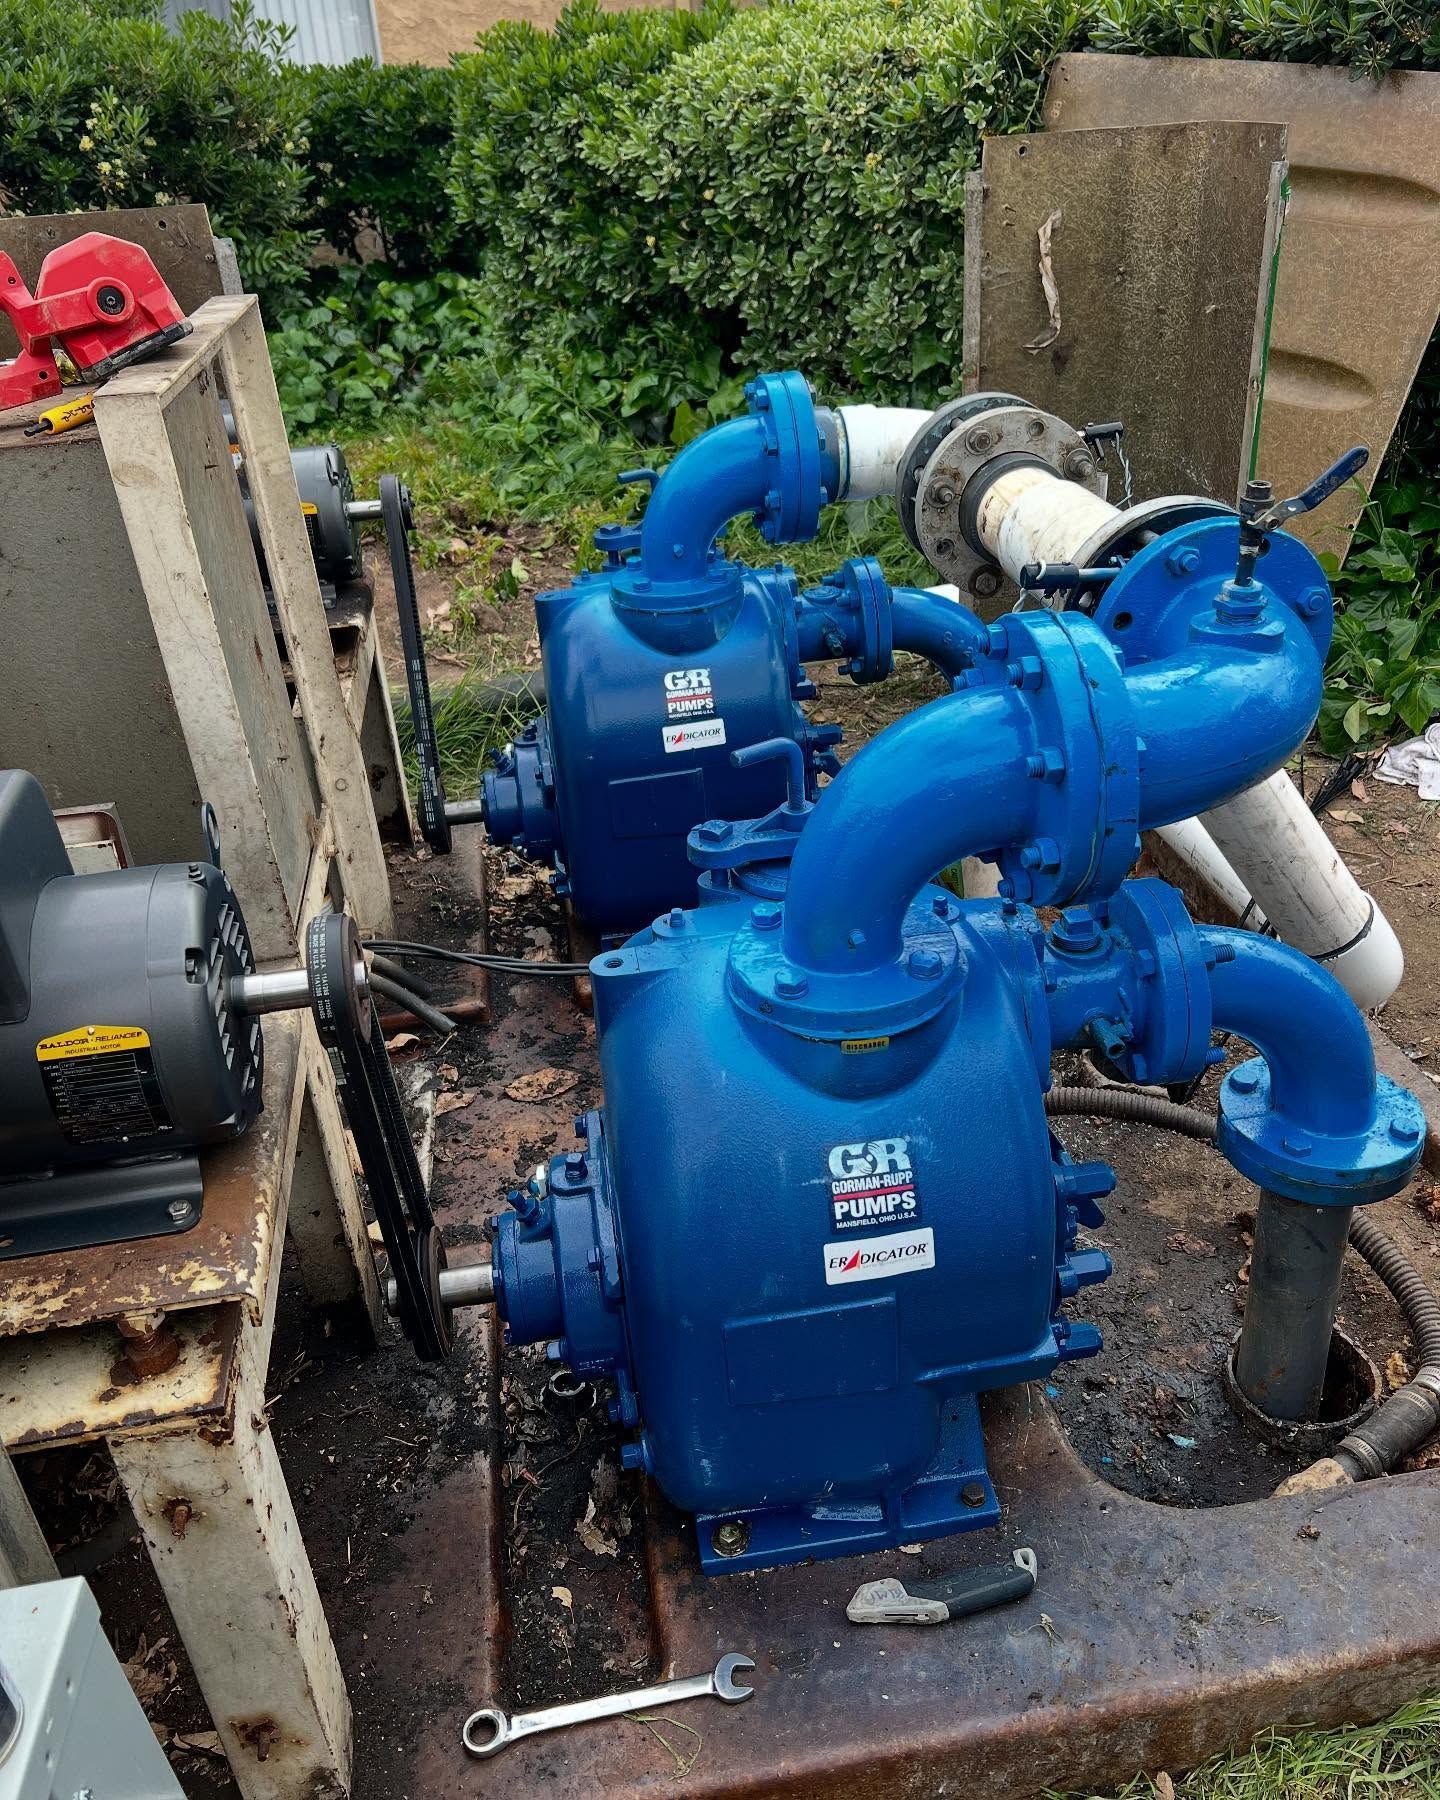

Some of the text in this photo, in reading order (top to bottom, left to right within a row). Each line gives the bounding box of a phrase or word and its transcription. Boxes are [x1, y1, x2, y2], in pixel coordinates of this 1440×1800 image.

[668, 698, 714, 713] PUMPS
[39, 1038, 89, 1050] BALDOR
[65, 1044, 121, 1055] INDUSTRIAL MOTOR
[832, 1171, 913, 1194] GORMAN-RUPP
[834, 1191, 916, 1220] PUMPS
[836, 1218, 878, 1229] MANSFIELD,
[879, 1214, 896, 1223] OHIO
